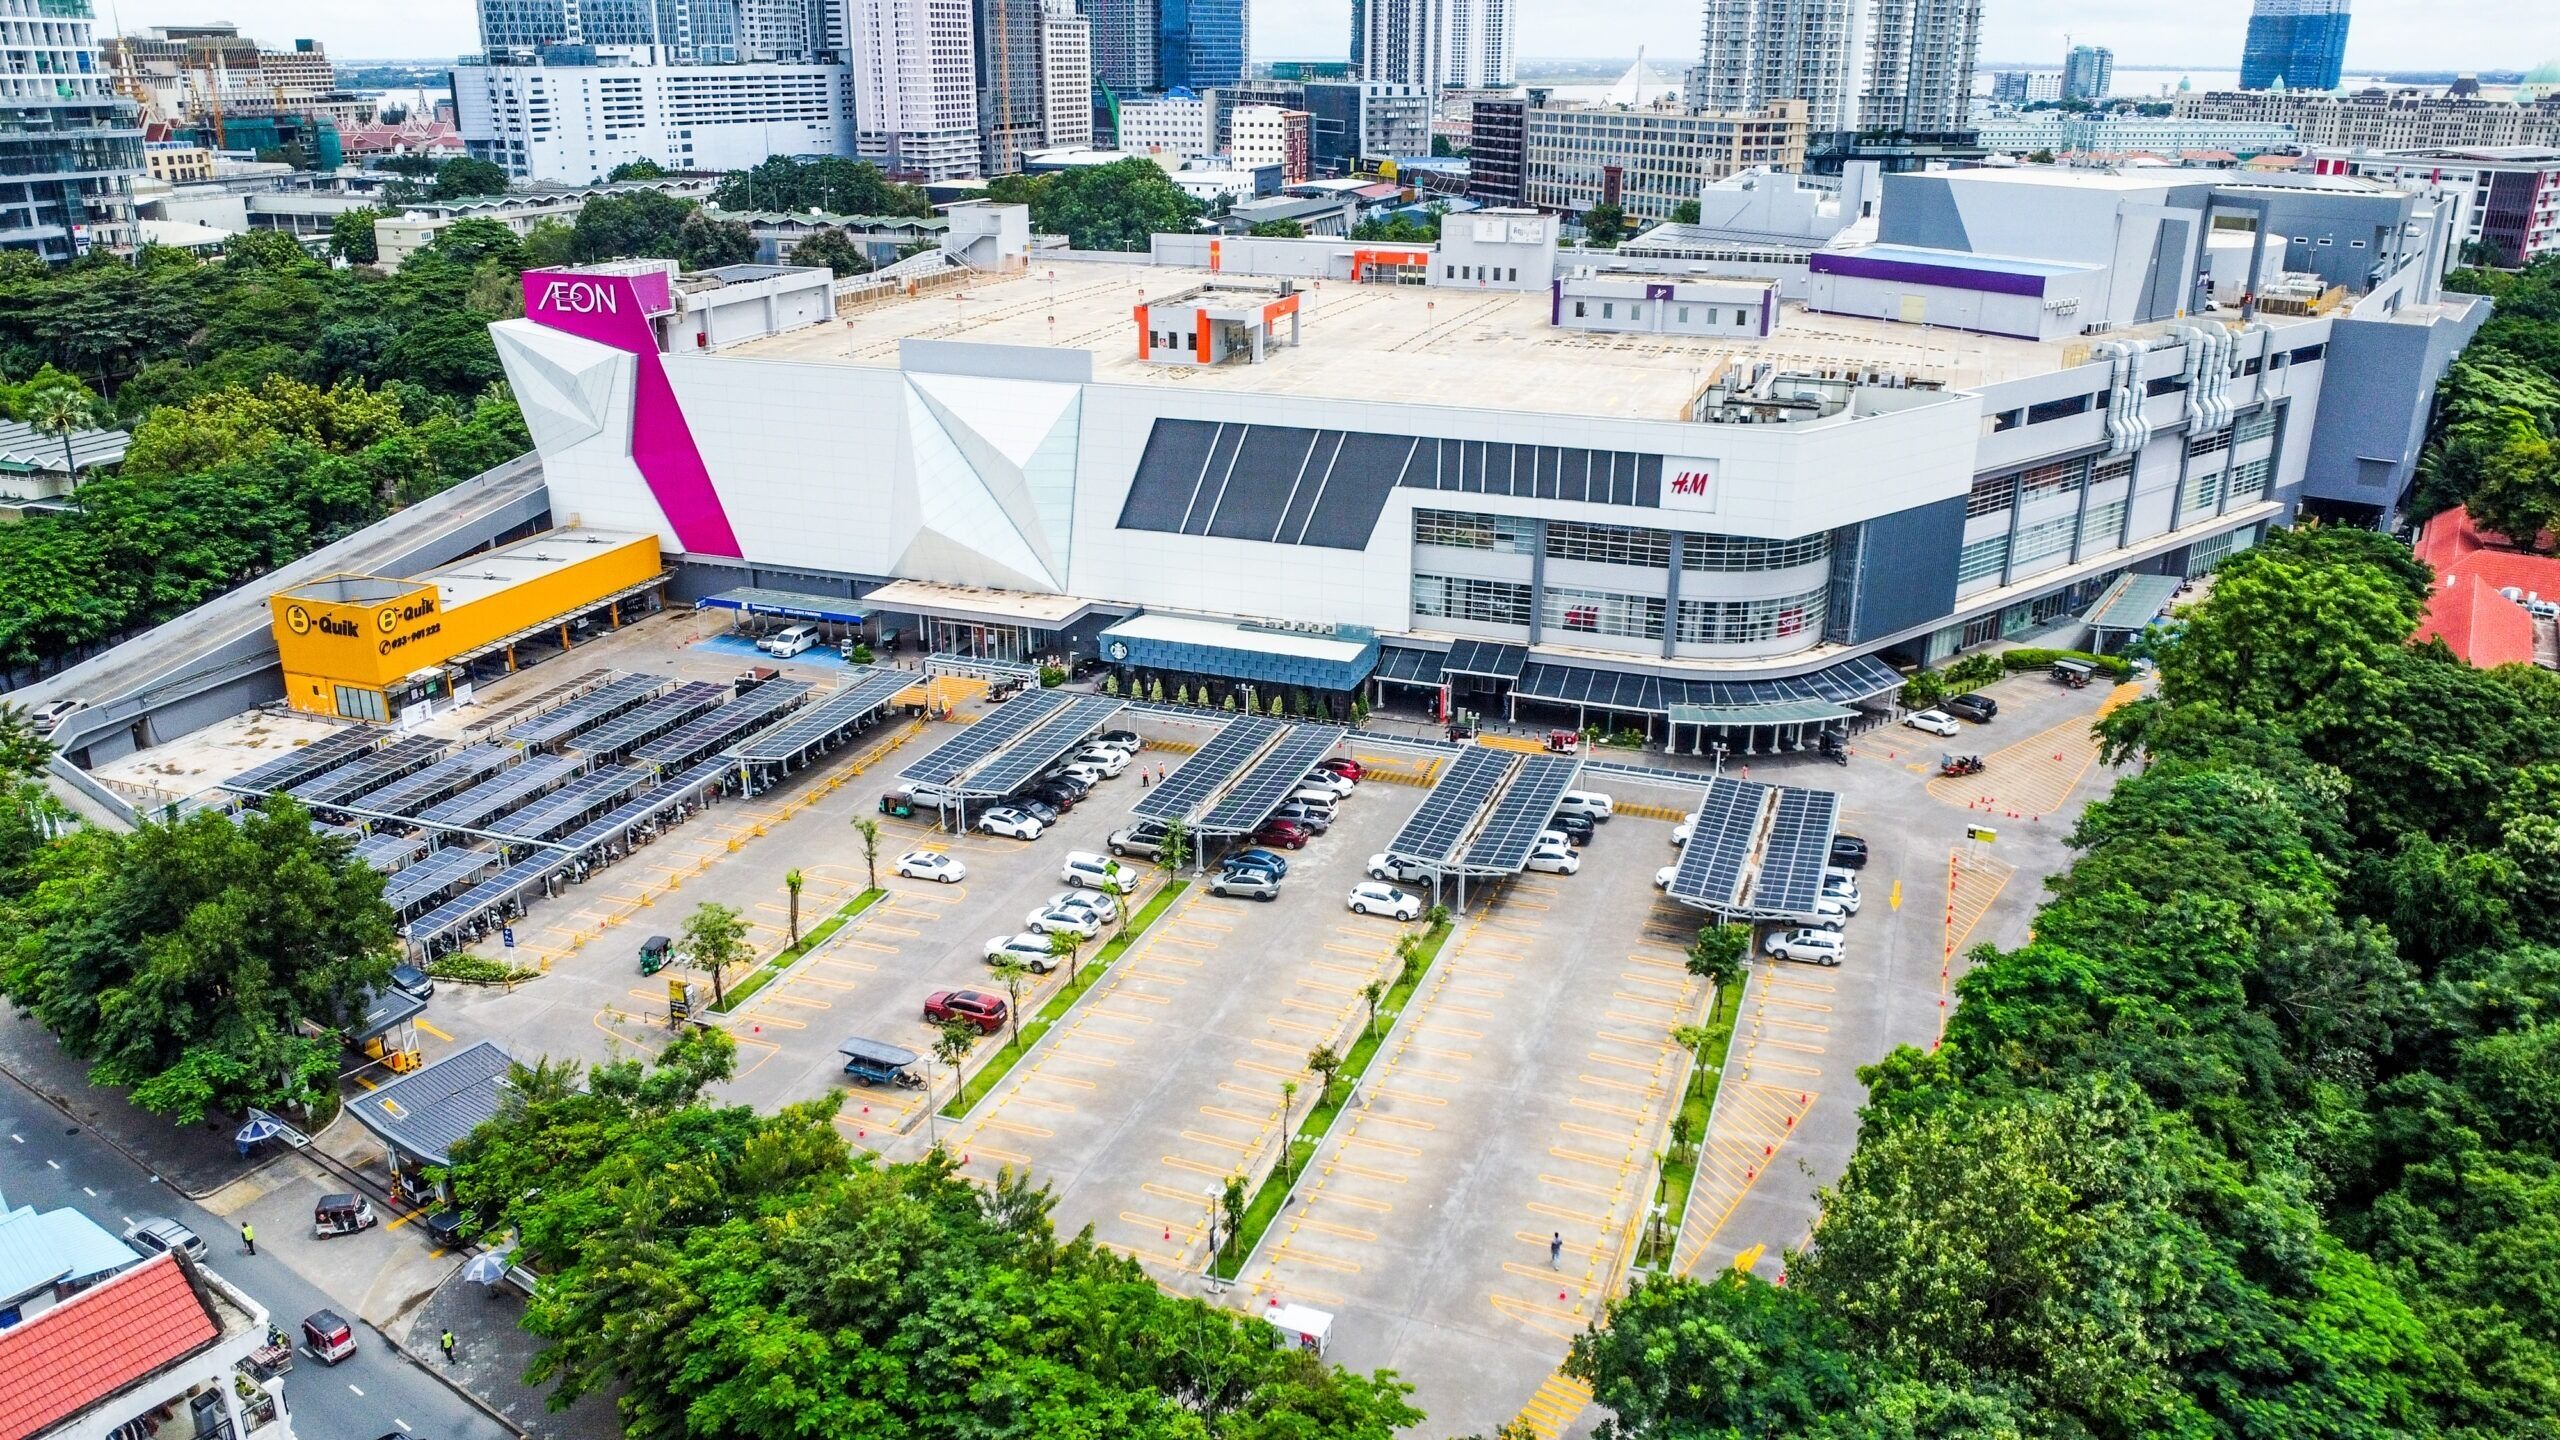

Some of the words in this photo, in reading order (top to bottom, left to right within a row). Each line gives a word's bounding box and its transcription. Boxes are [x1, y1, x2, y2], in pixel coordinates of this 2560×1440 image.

[1670, 471, 1709, 497] H&M
[286, 604, 359, 638] B-Quik
[378, 599, 434, 634] B-Quik
